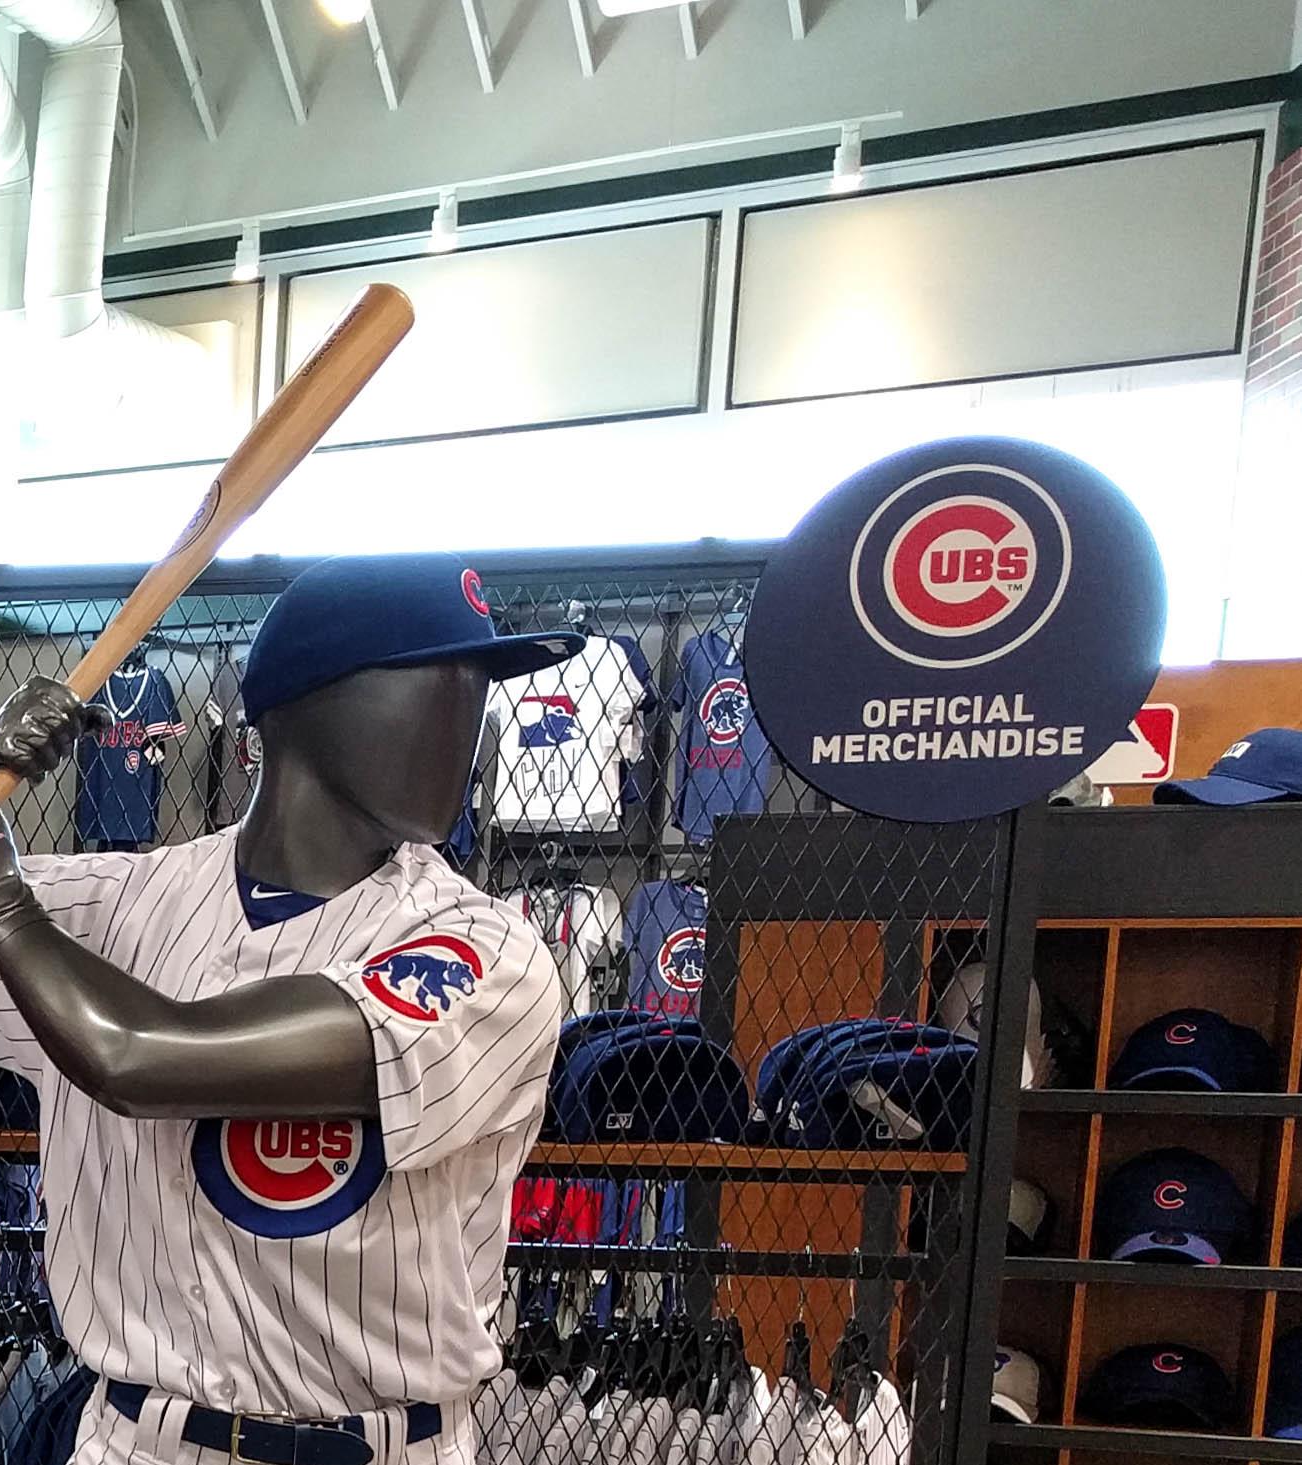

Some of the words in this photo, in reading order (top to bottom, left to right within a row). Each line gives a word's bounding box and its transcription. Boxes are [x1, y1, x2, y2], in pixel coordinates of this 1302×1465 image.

[893, 504, 1028, 628] CUBS
[862, 693, 1034, 728] OFFICIAL
[811, 726, 1085, 764] MERCHANDISE
[1153, 1180, 1188, 1210] C
